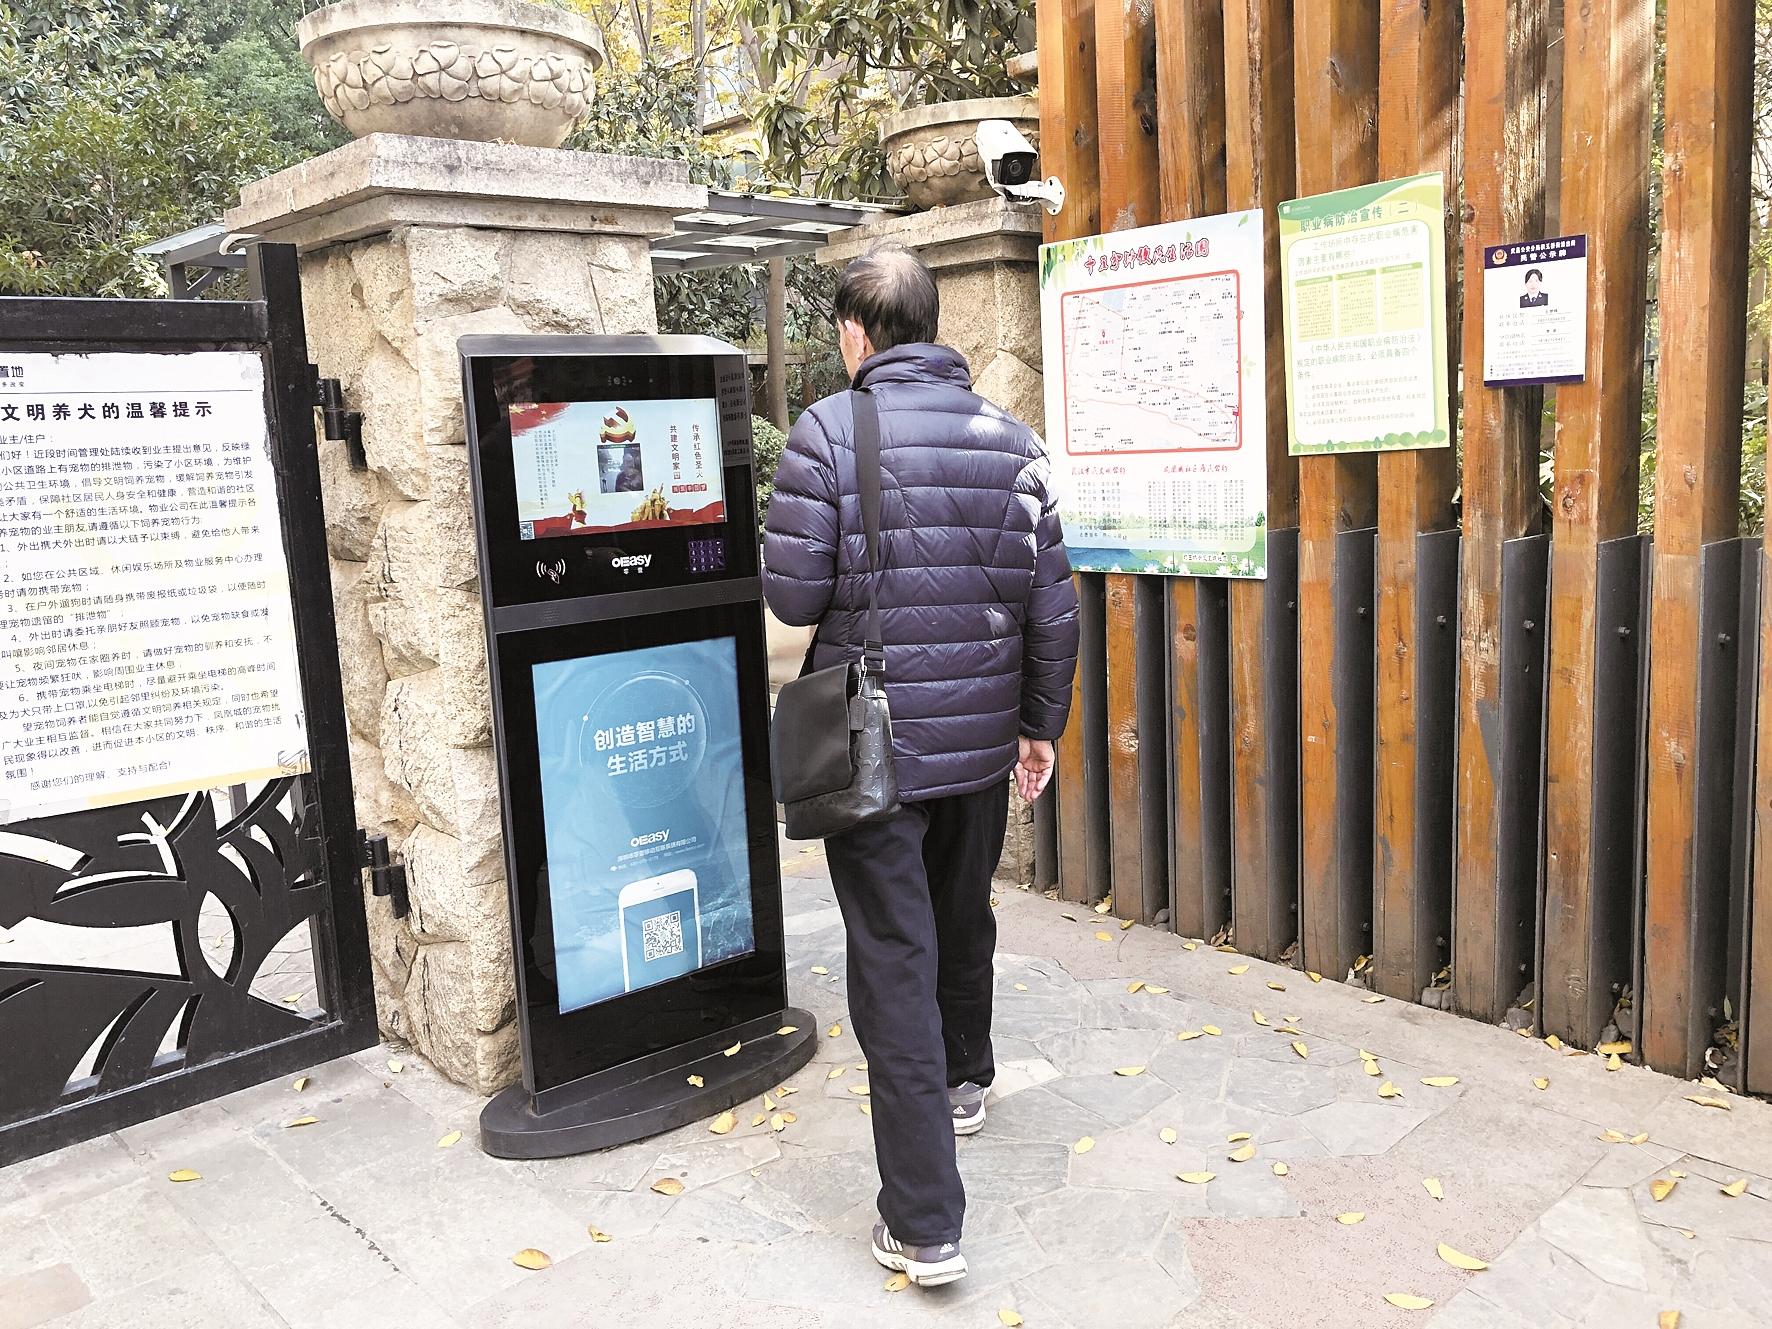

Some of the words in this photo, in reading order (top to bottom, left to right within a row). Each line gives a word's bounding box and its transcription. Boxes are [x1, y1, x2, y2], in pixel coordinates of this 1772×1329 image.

[1, 401, 213, 421] 文明养犬的温馨提示
[0, 470, 253, 491] 公共卫生环境，倡导文明饲养宠物，缓解饲养宠物引发
[593, 712, 696, 752] 创造智慧的
[607, 740, 689, 777] 生活方式
